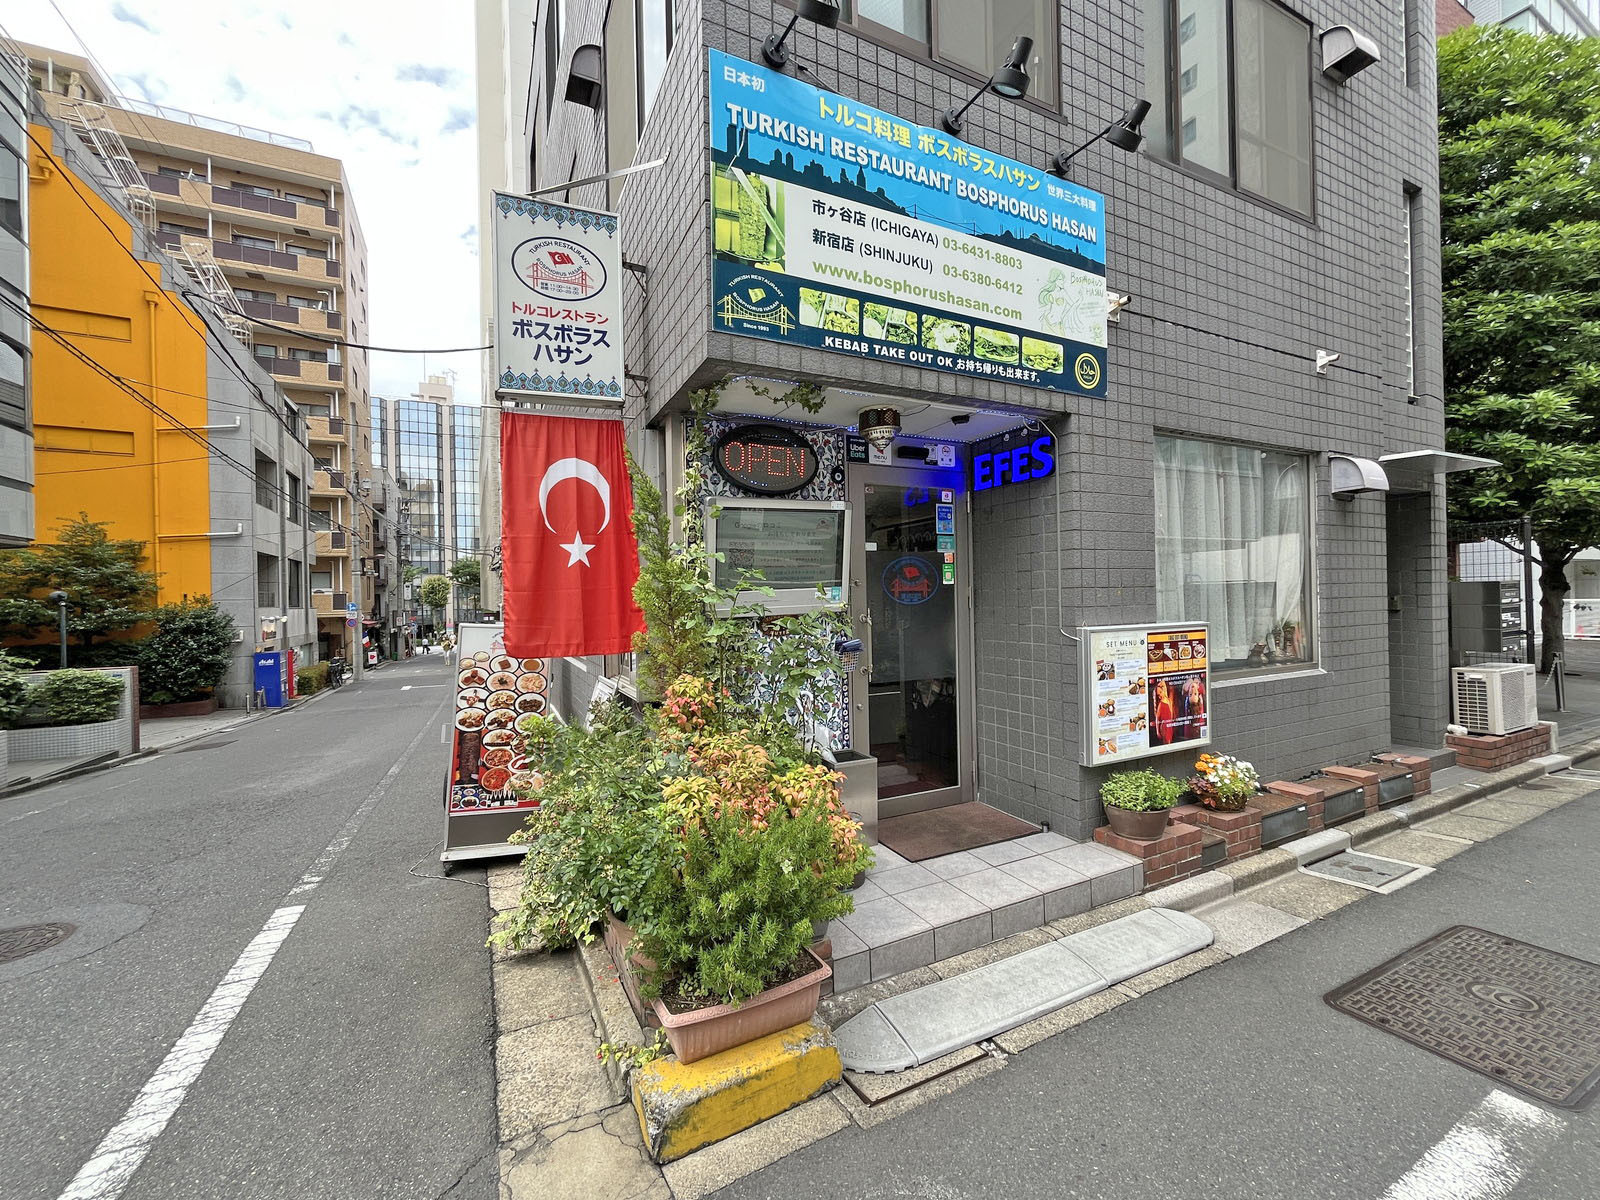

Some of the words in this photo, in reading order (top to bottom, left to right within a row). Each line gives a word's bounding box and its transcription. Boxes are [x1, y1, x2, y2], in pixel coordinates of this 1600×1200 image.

[724, 66, 765, 93] 日本初
[819, 97, 911, 148] トルコ料理
[727, 103, 824, 152] TURKISH
[830, 137, 952, 192] RESTAURANT
[956, 179, 1048, 226] BOSPHORUS
[1052, 213, 1097, 242] HASAN
[1047, 184, 1096, 212] 世界三大料理
[528, 241, 553, 254] TURKISH
[554, 241, 591, 266] RESTAURANT
[871, 216, 939, 249] (ICHIGAYA)
[943, 236, 1023, 270] 03-6431-8803
[812, 229, 854, 254] 新宿店
[860, 242, 933, 275] (SHINJUKU)
[943, 263, 1023, 295] 03-6380-6412
[729, 274, 751, 287] TURKISH
[751, 275, 784, 297] RESTAURANT
[813, 261, 1022, 320] www.bosphorushasan.com
[512, 302, 609, 324] トルコレストラン
[512, 319, 611, 348] ボスボラス
[533, 343, 593, 365] ハサン
[824, 336, 869, 353] KEBAB
[873, 345, 905, 359] TAKE
[910, 351, 933, 364] OUT
[937, 357, 953, 368] OK
[956, 358, 1041, 383] お持ち帰りも出来ます。
[725, 441, 804, 478] OPEN
[850, 443, 866, 452] Uber
[850, 451, 866, 459] Eats
[974, 436, 1053, 491] EFES
